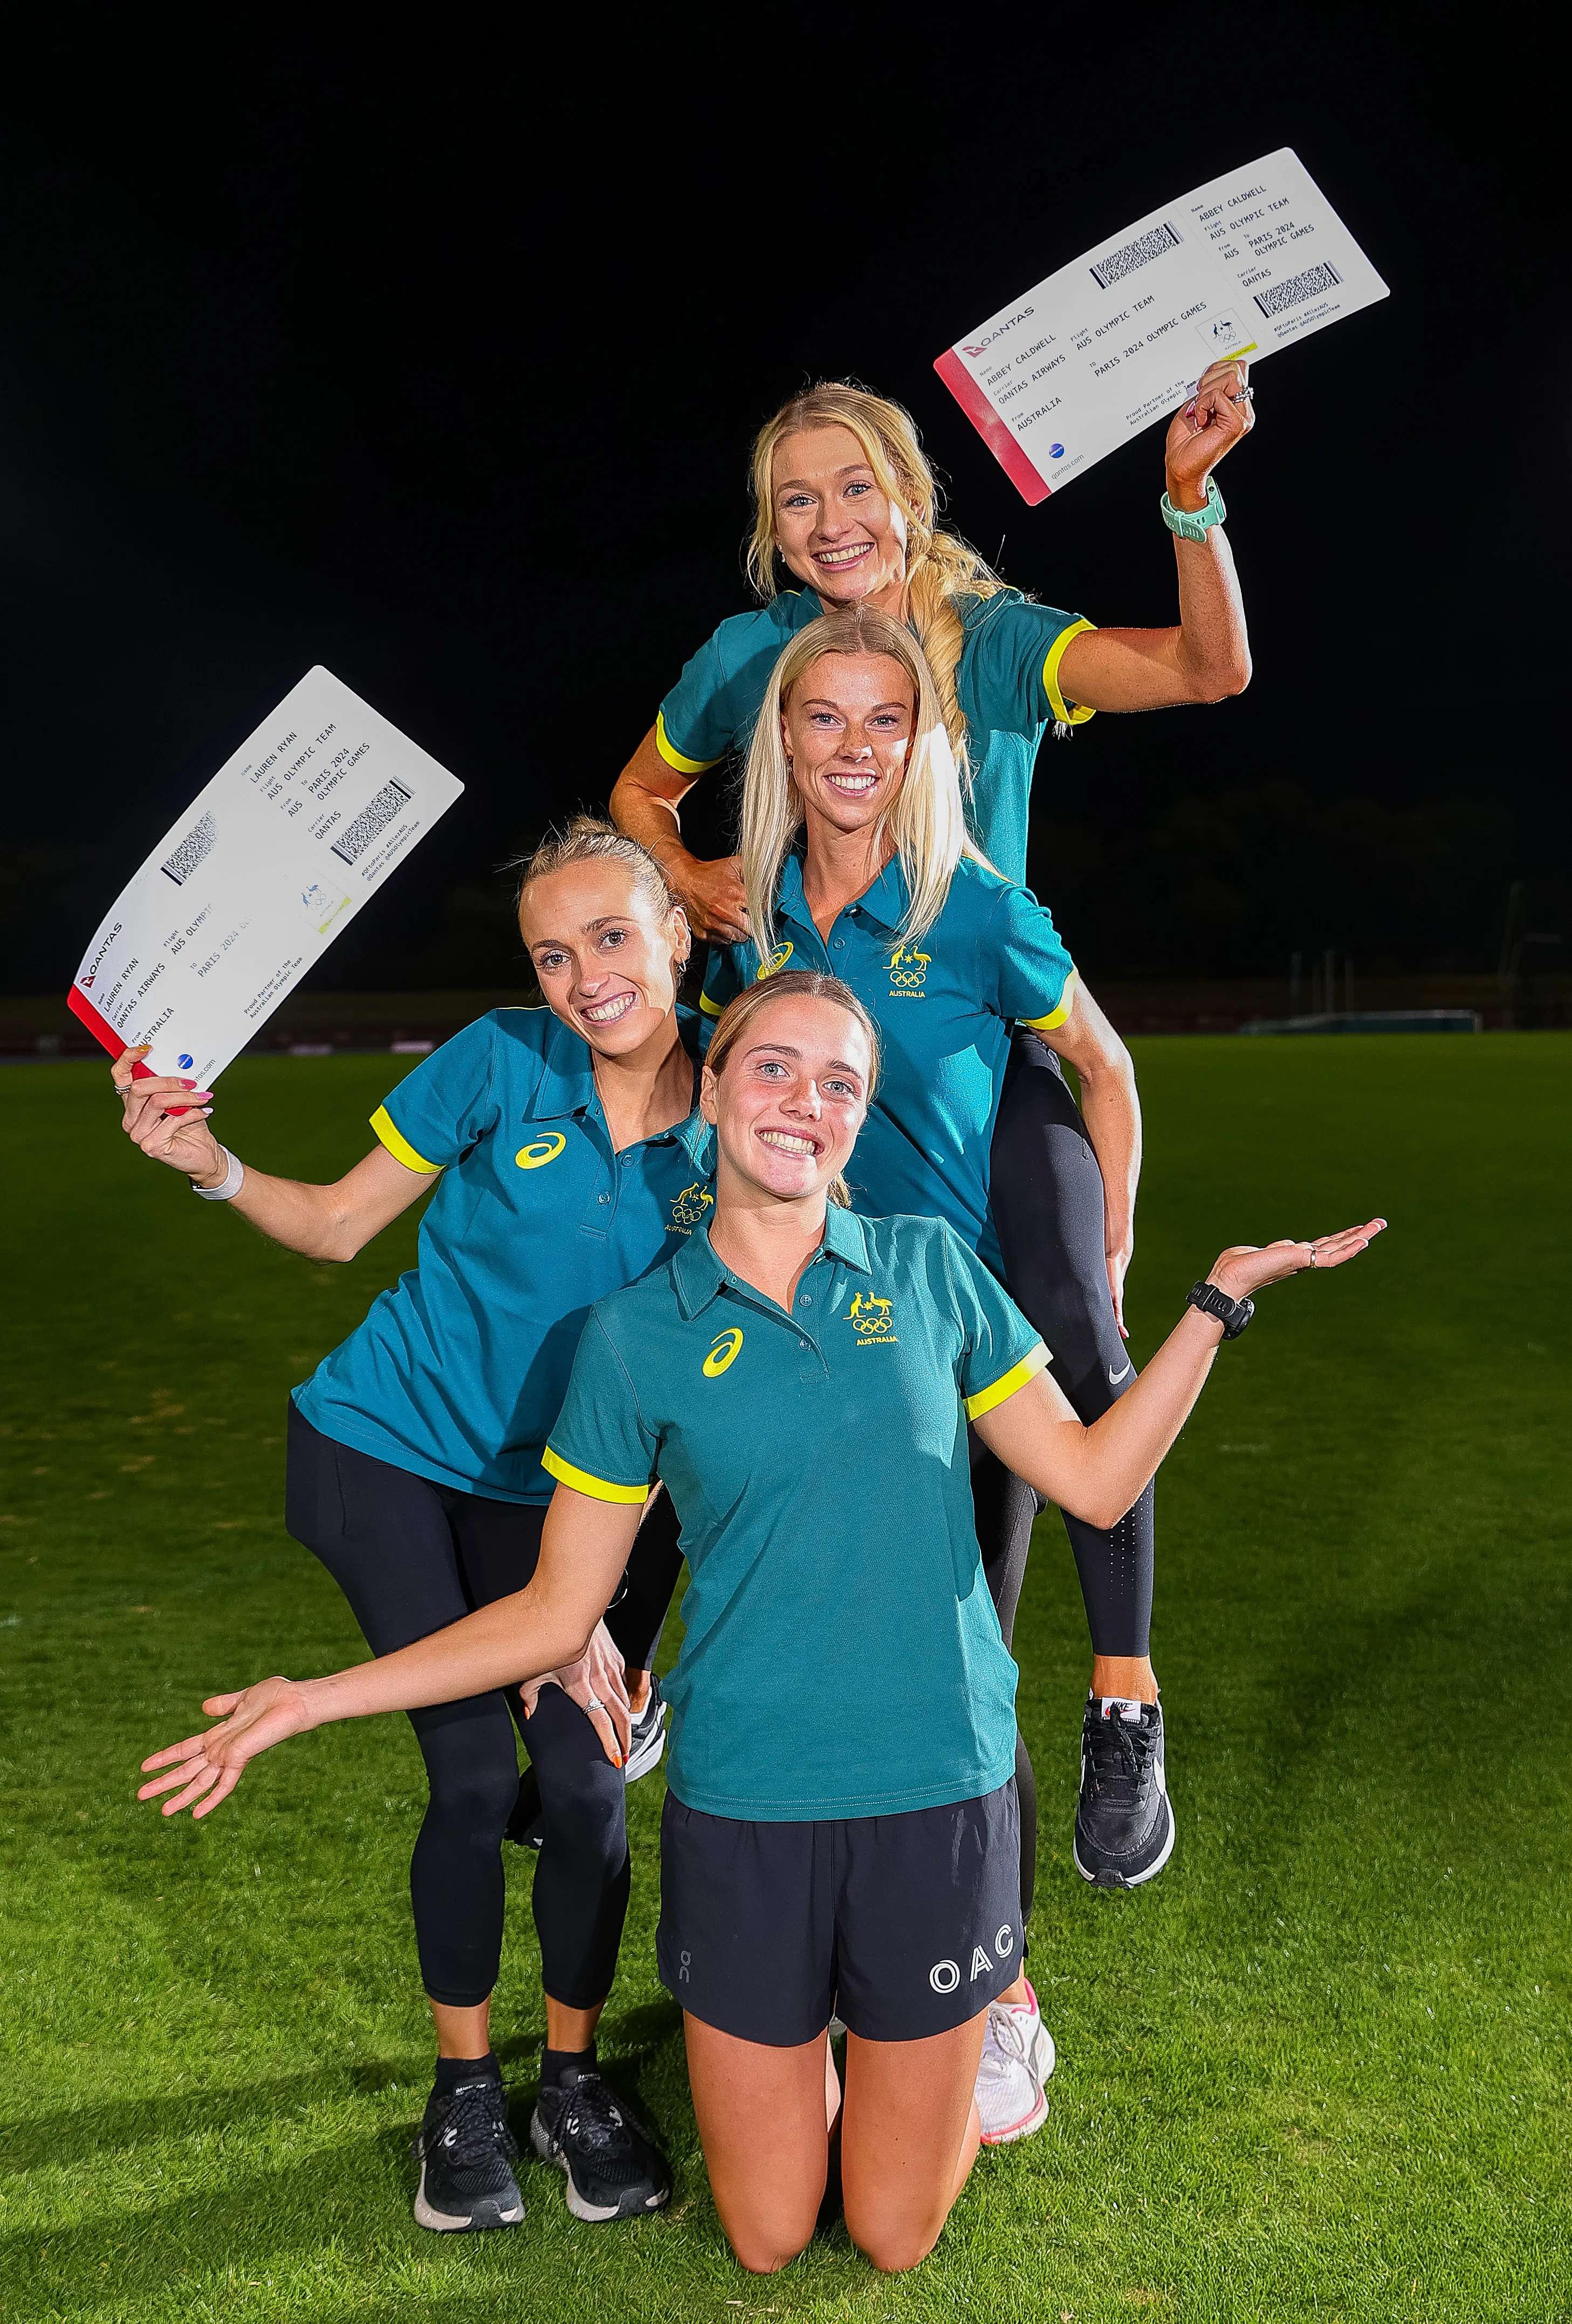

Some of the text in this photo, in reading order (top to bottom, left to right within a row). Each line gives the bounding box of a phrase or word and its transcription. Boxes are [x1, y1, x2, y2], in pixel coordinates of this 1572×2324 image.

[1199, 185, 1267, 222] ABBEY CALDWELL
[1210, 197, 1289, 240] AUS OLYMPIC TEAM
[1204, 221, 1222, 232] Flight
[1248, 222, 1295, 248] PARIS 2024
[1254, 224, 1314, 256] OLYMPIC GAMES
[1224, 248, 1239, 260] AUS
[1237, 266, 1257, 278] Carrier
[1242, 269, 1272, 287] QANTAS
[980, 306, 1034, 346] QANTAS
[1070, 328, 1088, 341] Flight
[1076, 295, 1155, 350] AUS OLYMPIC TEAM
[1094, 302, 1206, 377] PARIS 2024 OLYMPIC GAMES
[980, 366, 992, 377] Name
[987, 334, 1056, 386] ABBEY CALDWELL
[993, 380, 1013, 396] Carrier
[998, 354, 1066, 404] QANTAS AIRWAYS
[1011, 412, 1024, 423] From
[1017, 397, 1062, 431] AUSTRALIA
[1125, 408, 1142, 420] Proud
[1143, 393, 1164, 408] Partner
[1130, 380, 1197, 425] Australian Olympic Team
[1051, 454, 1084, 479] qantas.com
[241, 764, 252, 776] Name
[250, 732, 297, 783] LAUREN RYAN
[267, 723, 337, 800] AUS OLYMPIC TEAM
[308, 748, 349, 793] PARIS 2024
[317, 742, 370, 800] OLYMPIC GAMES
[259, 775, 276, 793] Flight
[280, 798, 292, 810] From
[287, 801, 303, 817] AUS
[307, 813, 325, 833] Carrier
[314, 810, 341, 840] QANTAS
[361, 824, 408, 877] #QFtoParis #AllezAUS
[366, 821, 420, 882] @Qantas @AUSOlympicTeam
[90, 922, 122, 975] QANTAS
[163, 930, 180, 947] Flight
[171, 938, 186, 955] AUS
[197, 930, 239, 977] PARIS 2024
[104, 958, 139, 1013] LAUREN RYAN
[116, 962, 165, 1028] QANTAS AIRWAYS
[244, 999, 258, 1014] Proud
[257, 978, 275, 998] Partner
[282, 959, 292, 969] the
[250, 957, 303, 1019] Australian Olympic Team
[112, 1001, 124, 1021] Carrier
[664, 1225, 692, 1235] AUSTRALIA
[856, 1336, 899, 1346] AUSTRALIA
